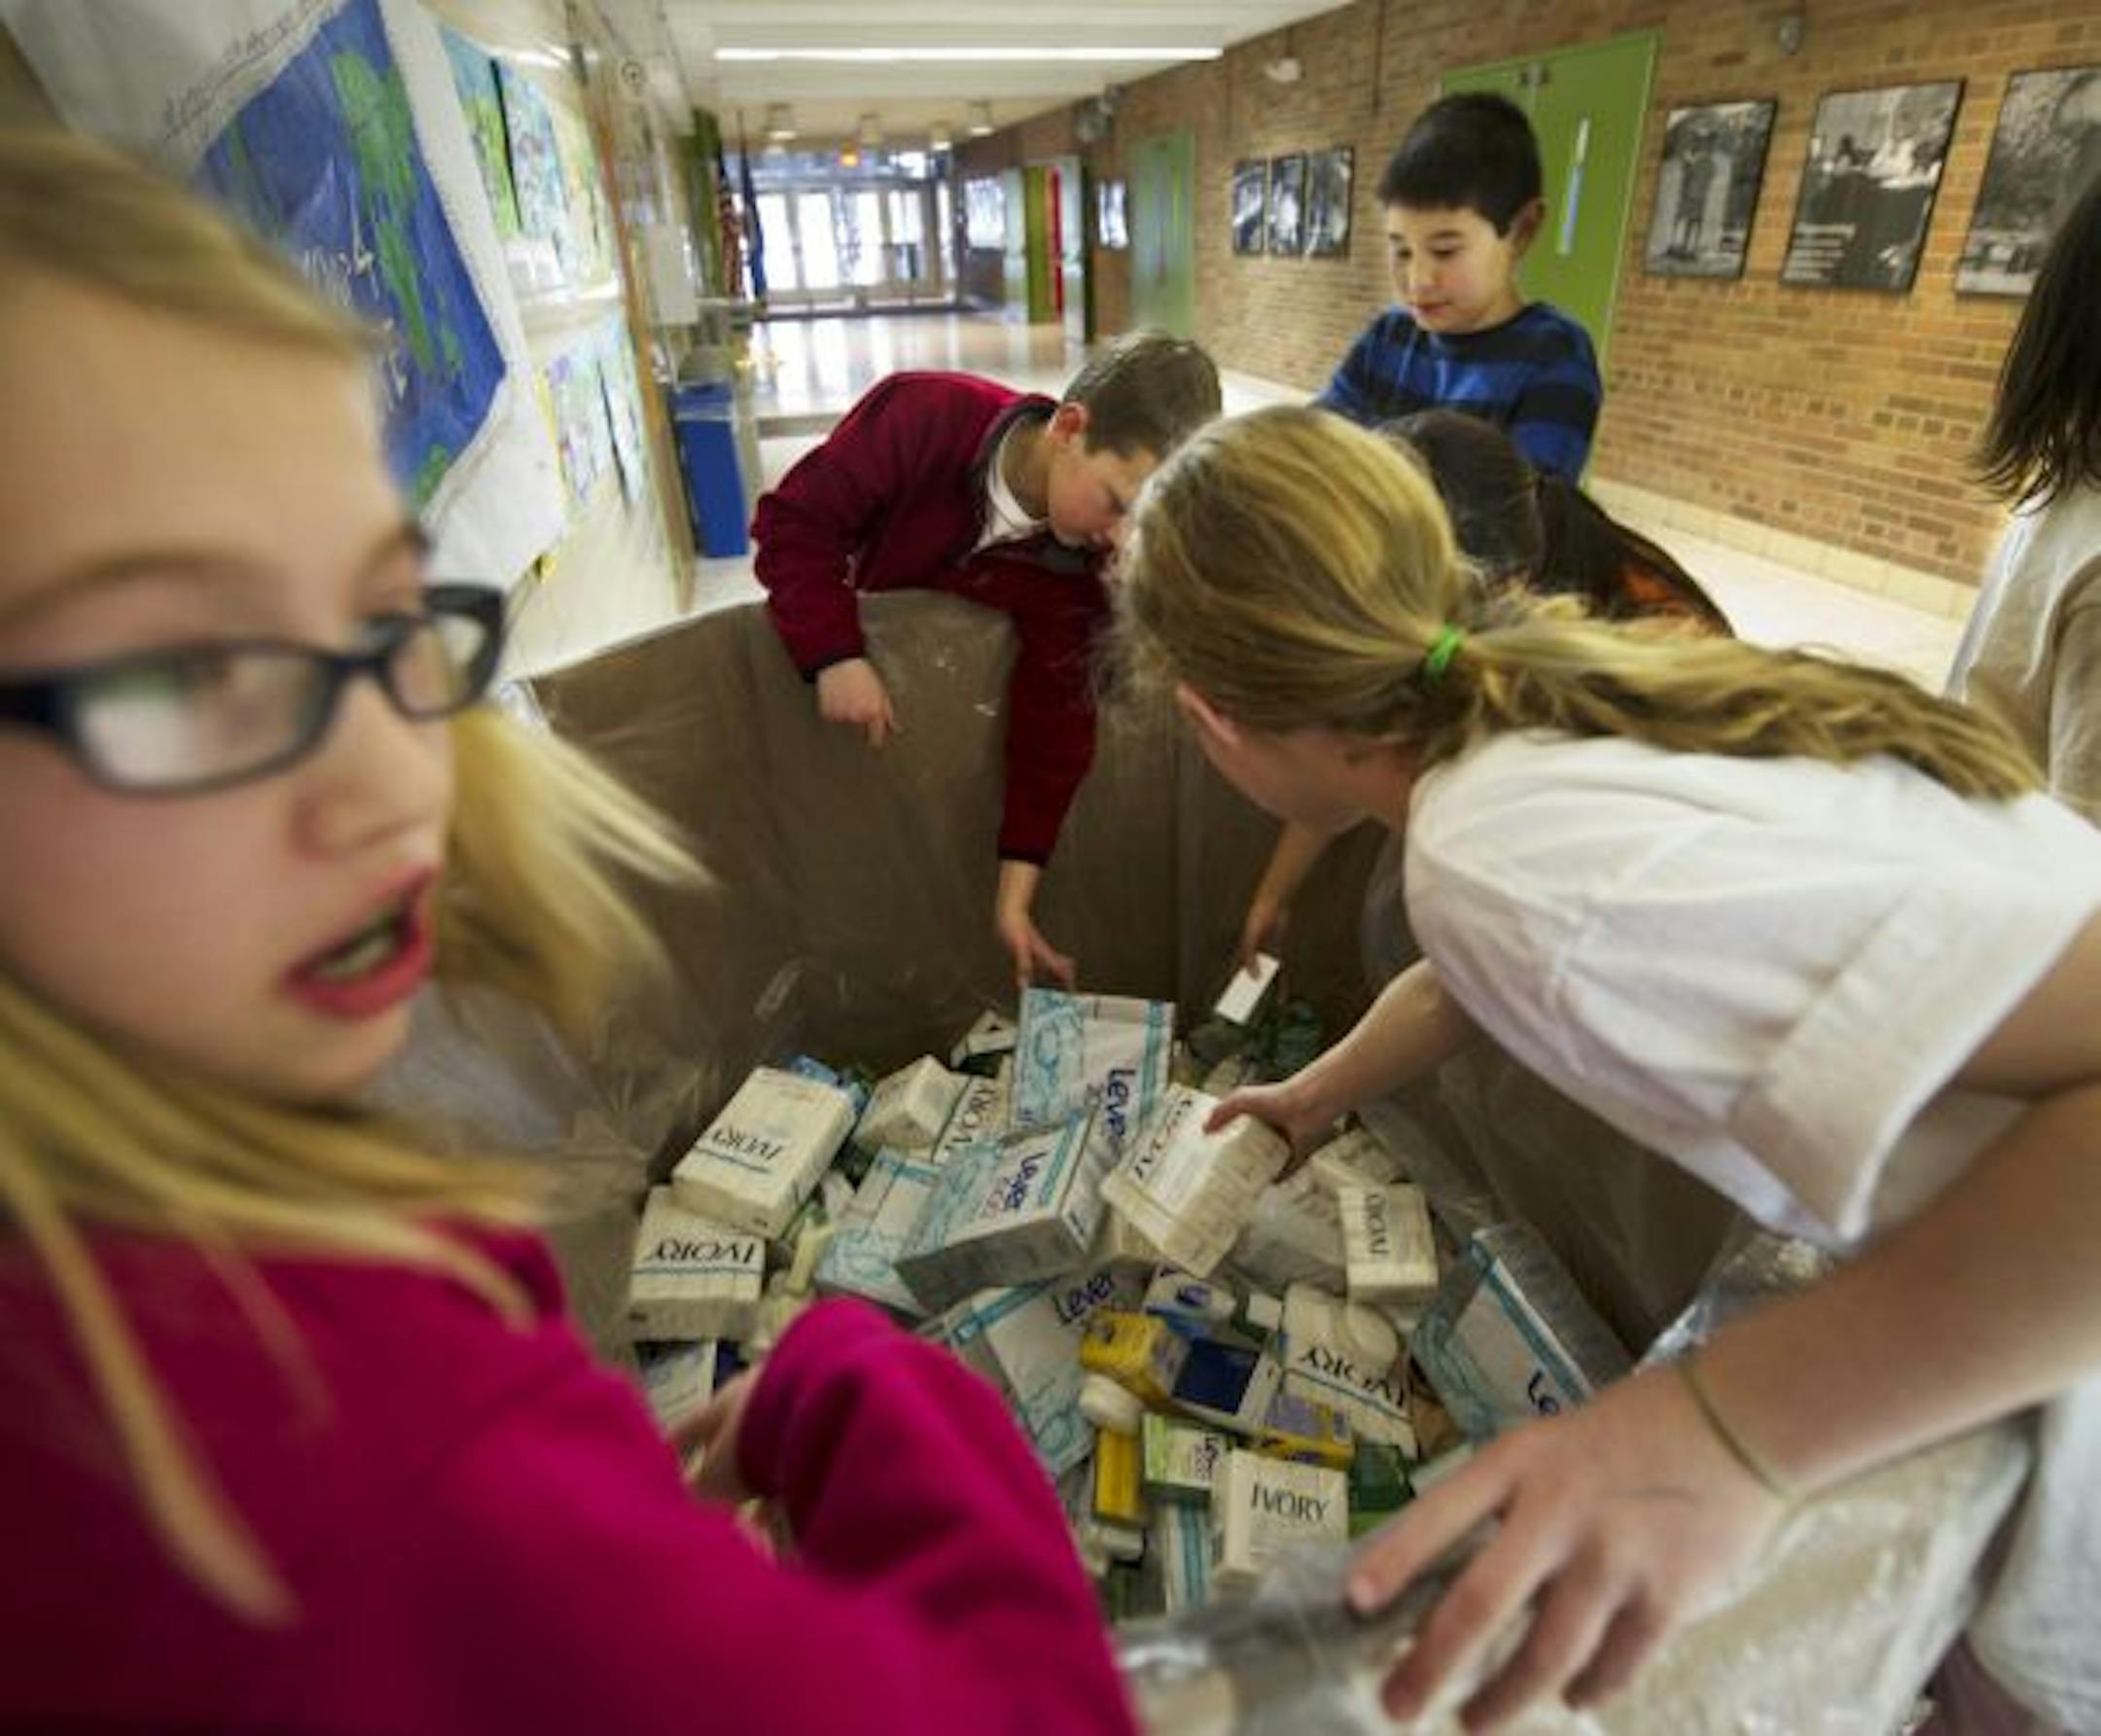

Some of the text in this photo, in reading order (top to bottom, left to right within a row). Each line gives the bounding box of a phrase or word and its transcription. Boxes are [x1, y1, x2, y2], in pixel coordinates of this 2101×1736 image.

[644, 1238, 756, 1263] IVORY
[1050, 1270, 1116, 1325] Lever
[1250, 1482, 1332, 1523] IVORY
